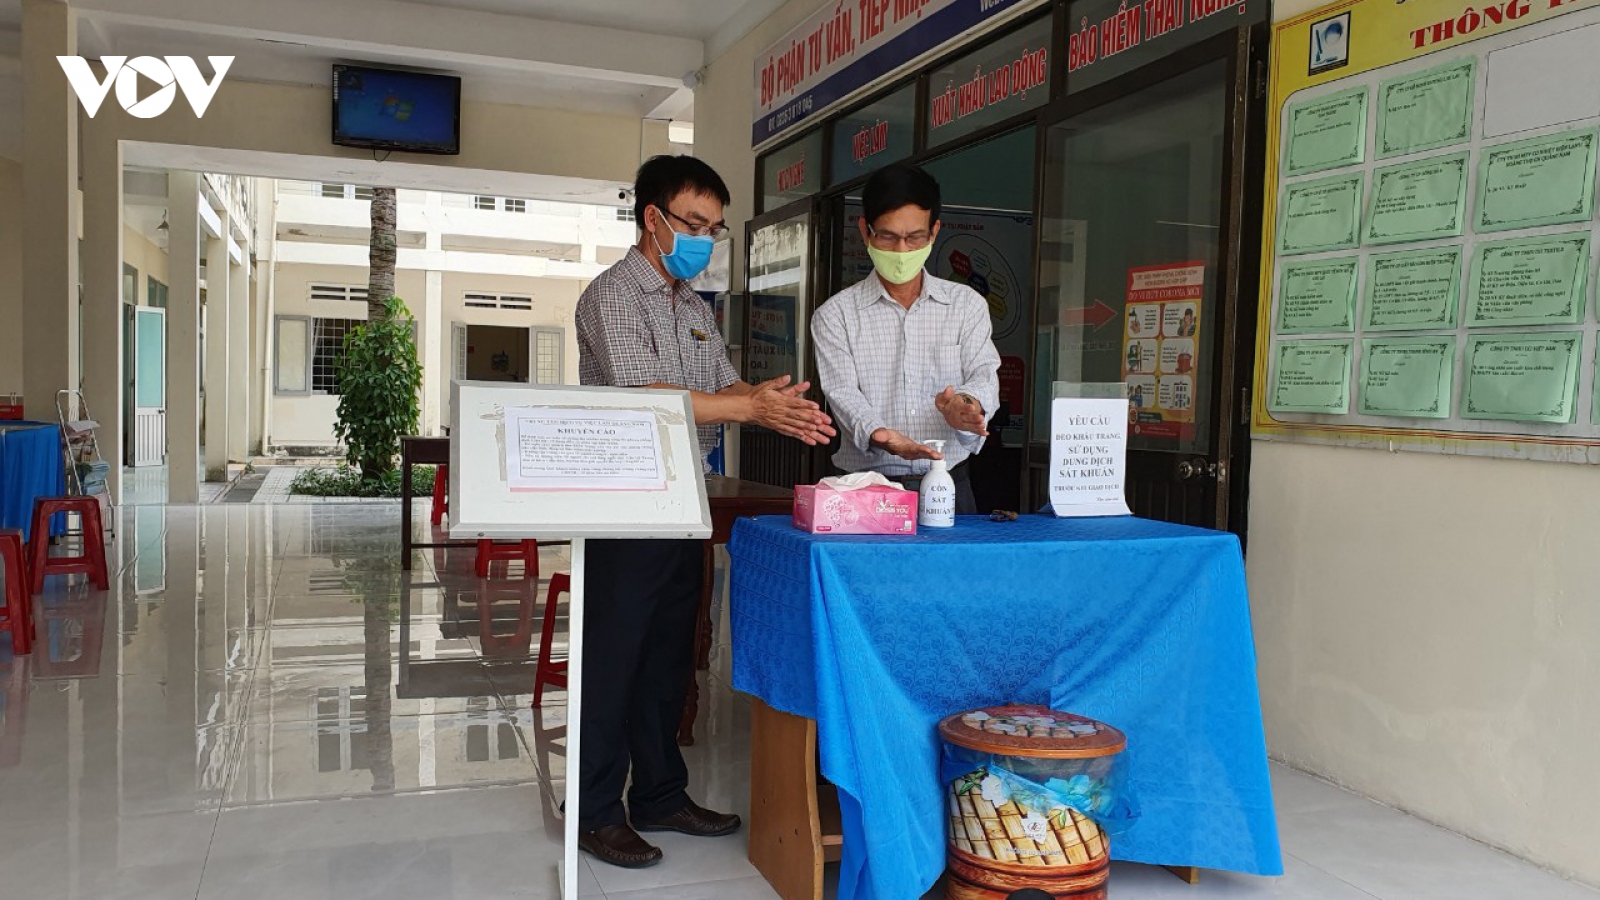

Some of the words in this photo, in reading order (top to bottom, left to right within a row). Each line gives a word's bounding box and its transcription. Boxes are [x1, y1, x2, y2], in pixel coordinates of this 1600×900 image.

[1410, 0, 1531, 49] THÔNG
[1068, 16, 1098, 73] BẢO
[1100, 0, 1141, 60] HIỂM
[761, 55, 775, 110] BỘ
[777, 39, 805, 97] PHẬN
[931, 80, 957, 130] XUẤT
[957, 65, 987, 119] KHẨU
[988, 65, 1011, 106] LAO
[1011, 47, 1047, 101] ĐỘNG
[1068, 415, 1088, 426] YÊU
[1090, 415, 1111, 426] CẦU
[1073, 433, 1094, 441] KHẨU
[1083, 446, 1109, 456] DỤNG
[1063, 458, 1088, 466] DUNG
[1090, 457, 1113, 467] DỊCH
[1059, 468, 1078, 478] SÁT
[1080, 468, 1115, 477] KHUẨN
